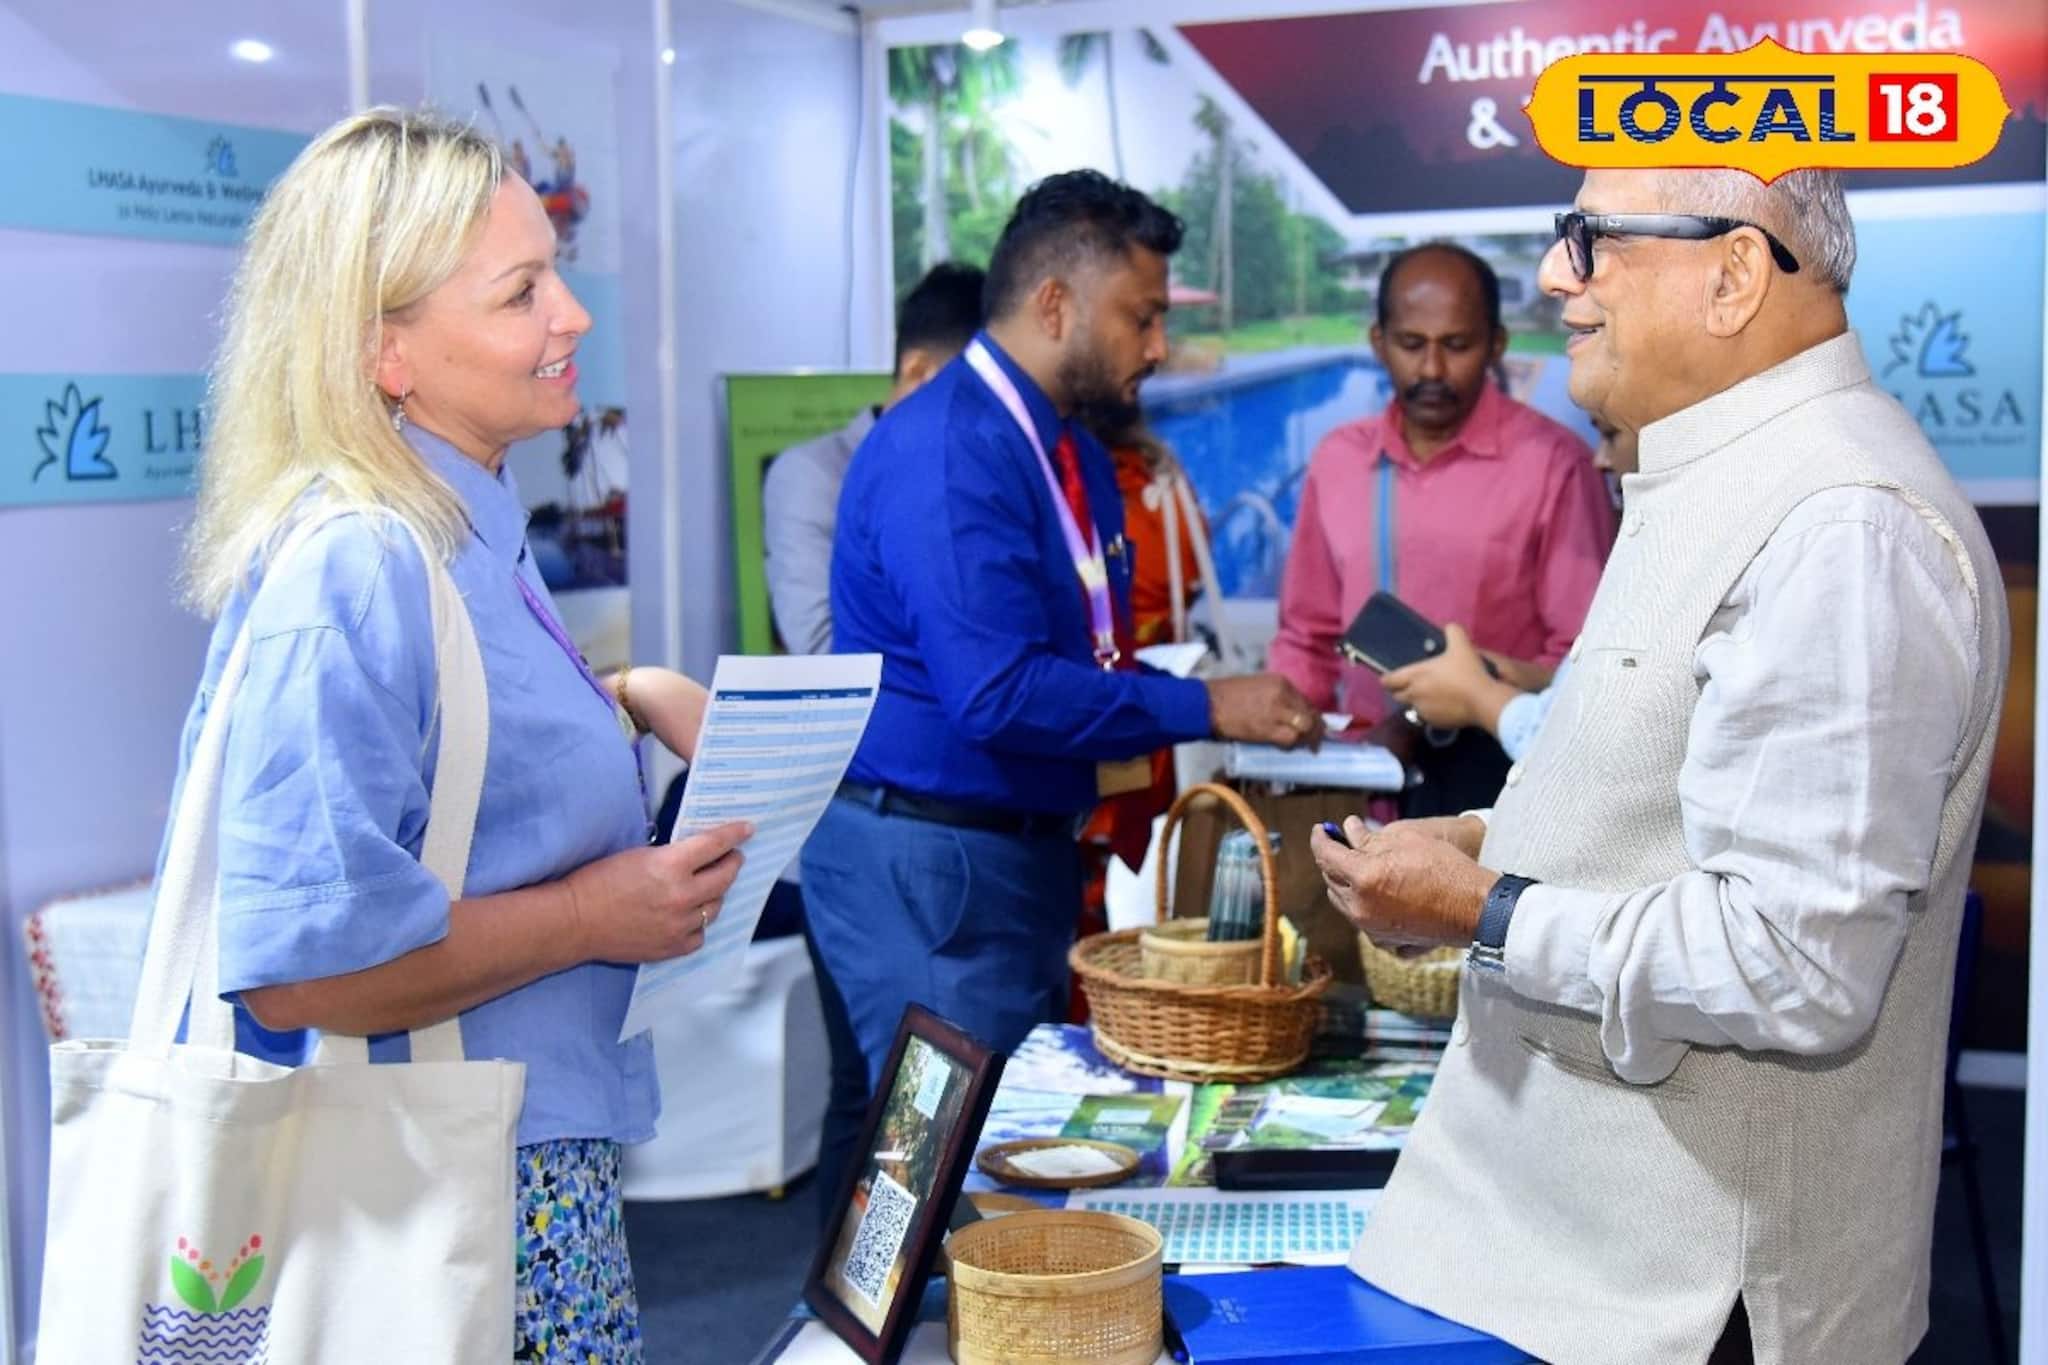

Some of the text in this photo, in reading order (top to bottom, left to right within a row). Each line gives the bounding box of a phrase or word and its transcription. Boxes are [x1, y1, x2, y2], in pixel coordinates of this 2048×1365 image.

[1466, 97, 1519, 149] &
[1893, 388, 2024, 427] ASA
[144, 409, 200, 453] LH
